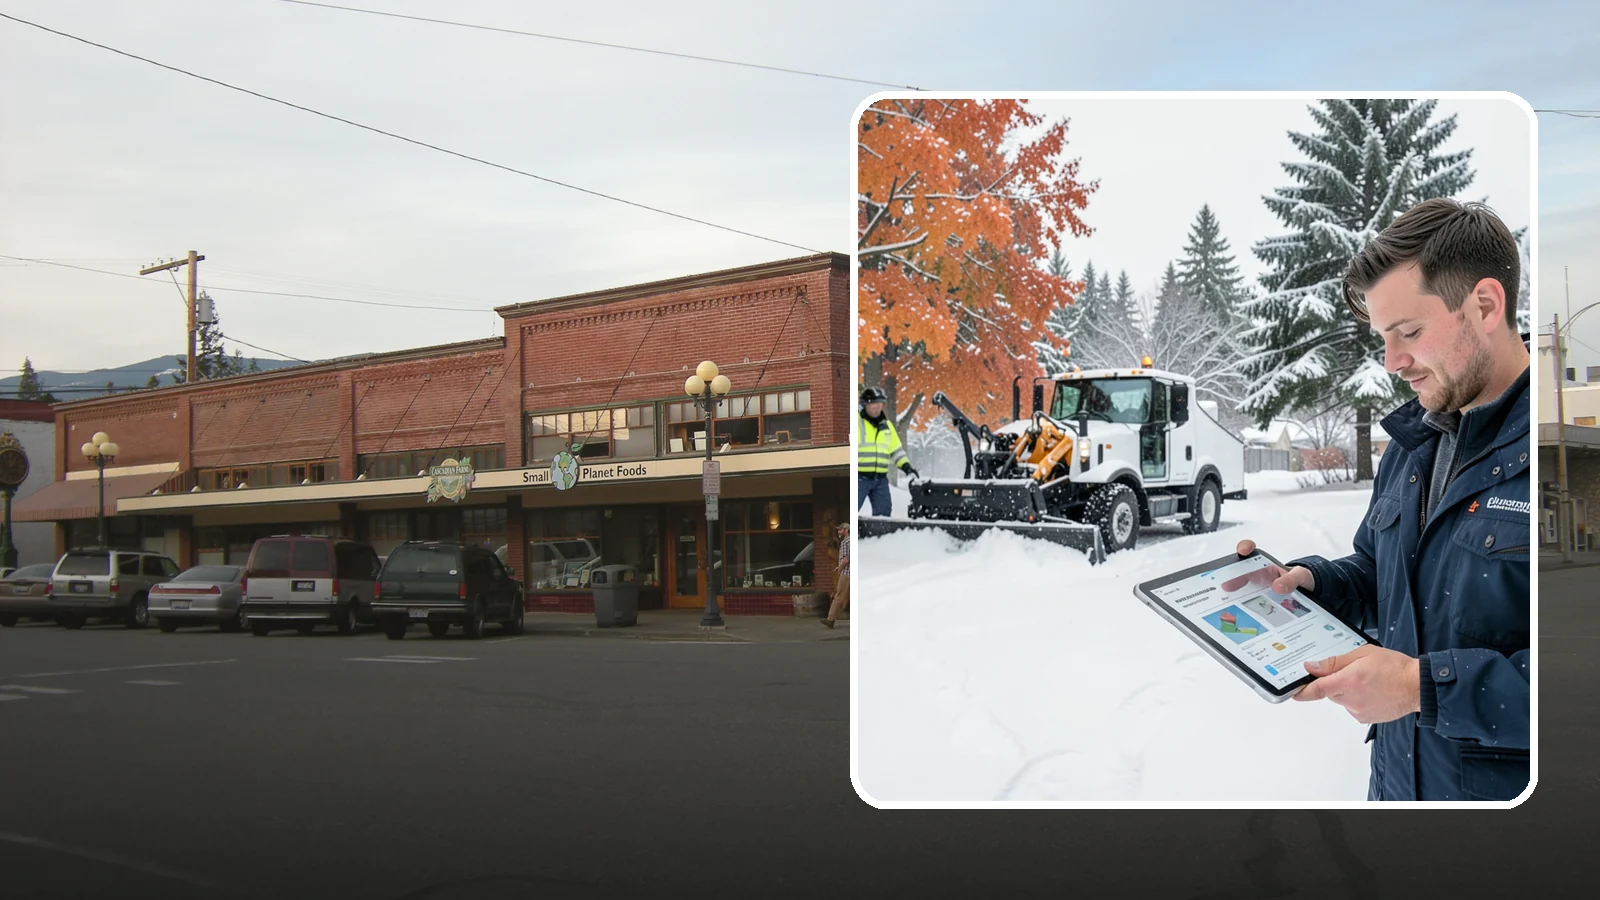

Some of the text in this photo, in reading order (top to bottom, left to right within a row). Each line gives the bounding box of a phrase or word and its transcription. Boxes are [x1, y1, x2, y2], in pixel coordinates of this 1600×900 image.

[456, 465, 469, 474] FARM
[523, 464, 647, 482] Small Planet Foods
